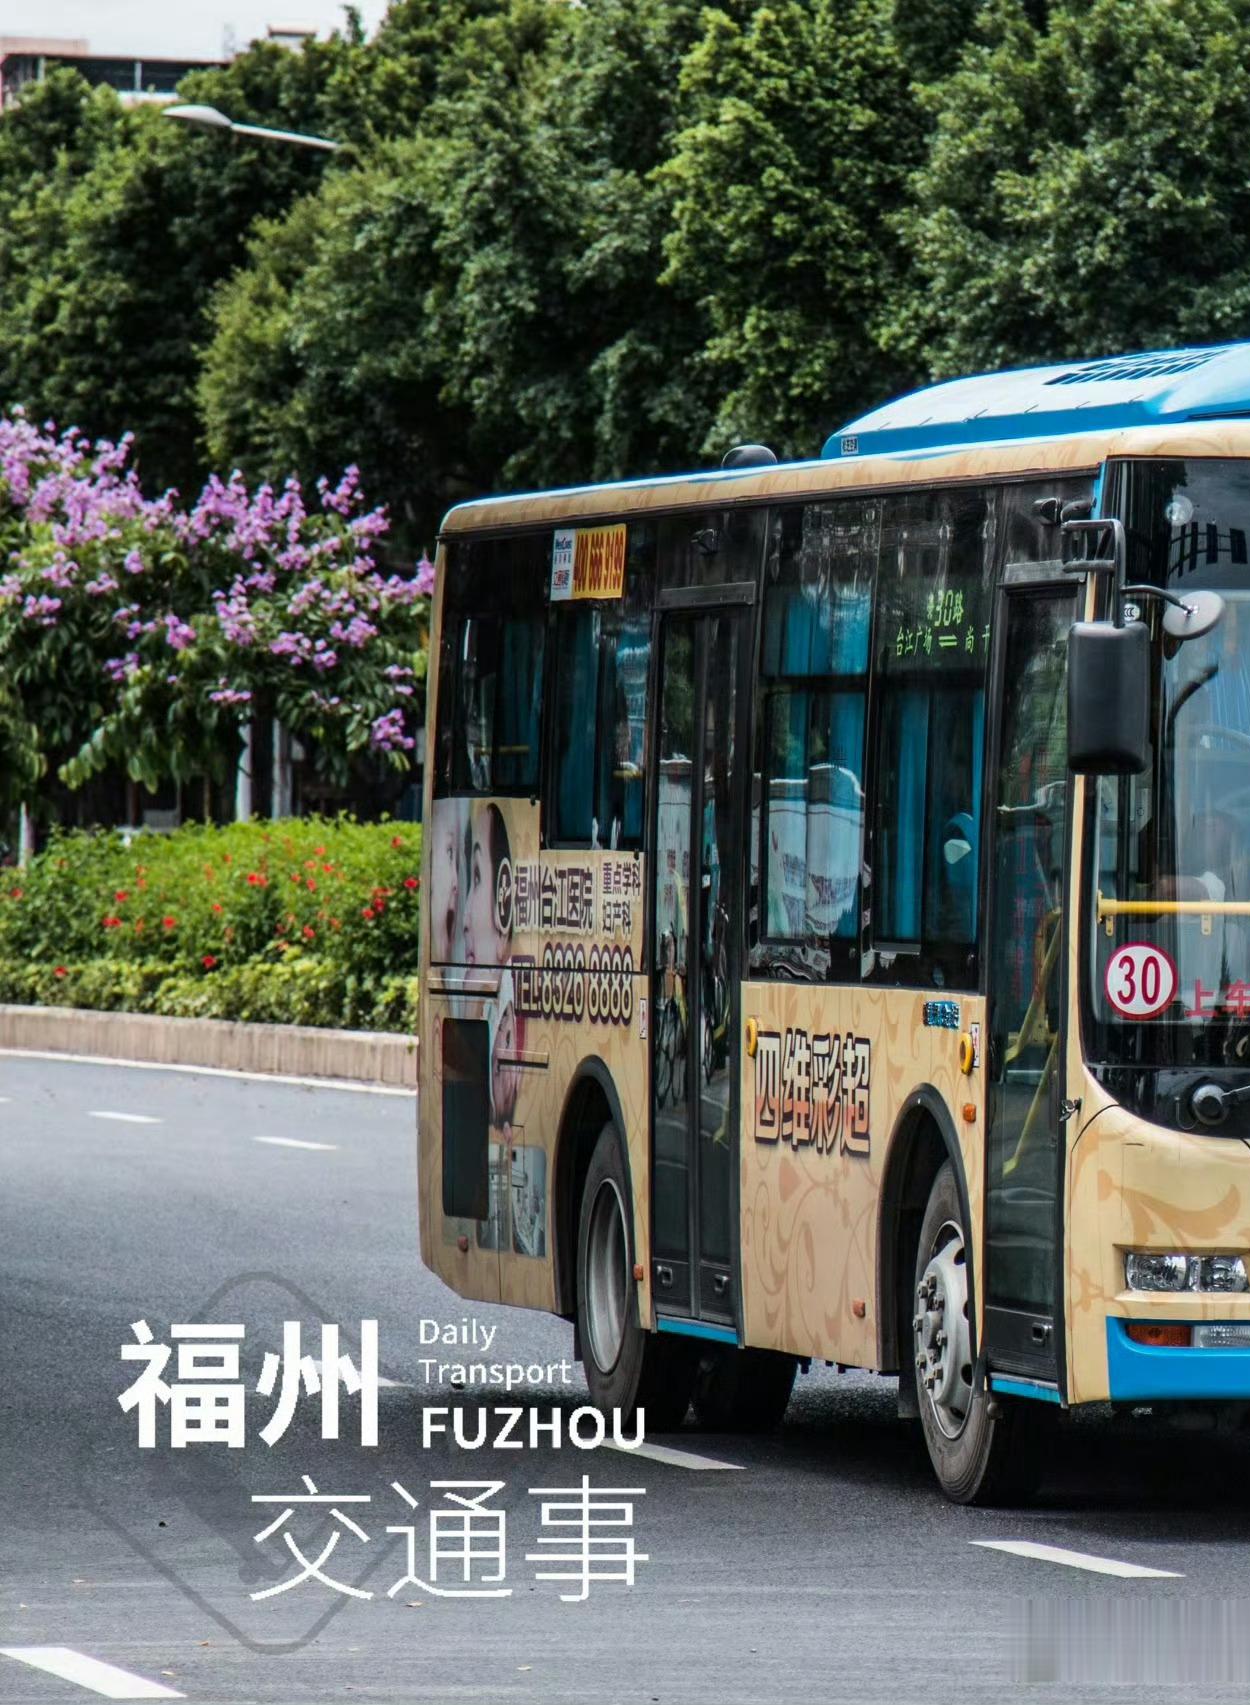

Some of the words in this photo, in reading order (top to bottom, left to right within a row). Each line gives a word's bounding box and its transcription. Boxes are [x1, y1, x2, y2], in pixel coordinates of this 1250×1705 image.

[896, 625, 932, 656] 台江广场
[515, 865, 594, 928] 福州台江医院
[603, 862, 640, 896] 重点学科
[603, 900, 631, 934] 妇产科
[1117, 955, 1161, 1004] 30
[755, 1027, 870, 1155] 四维彩超
